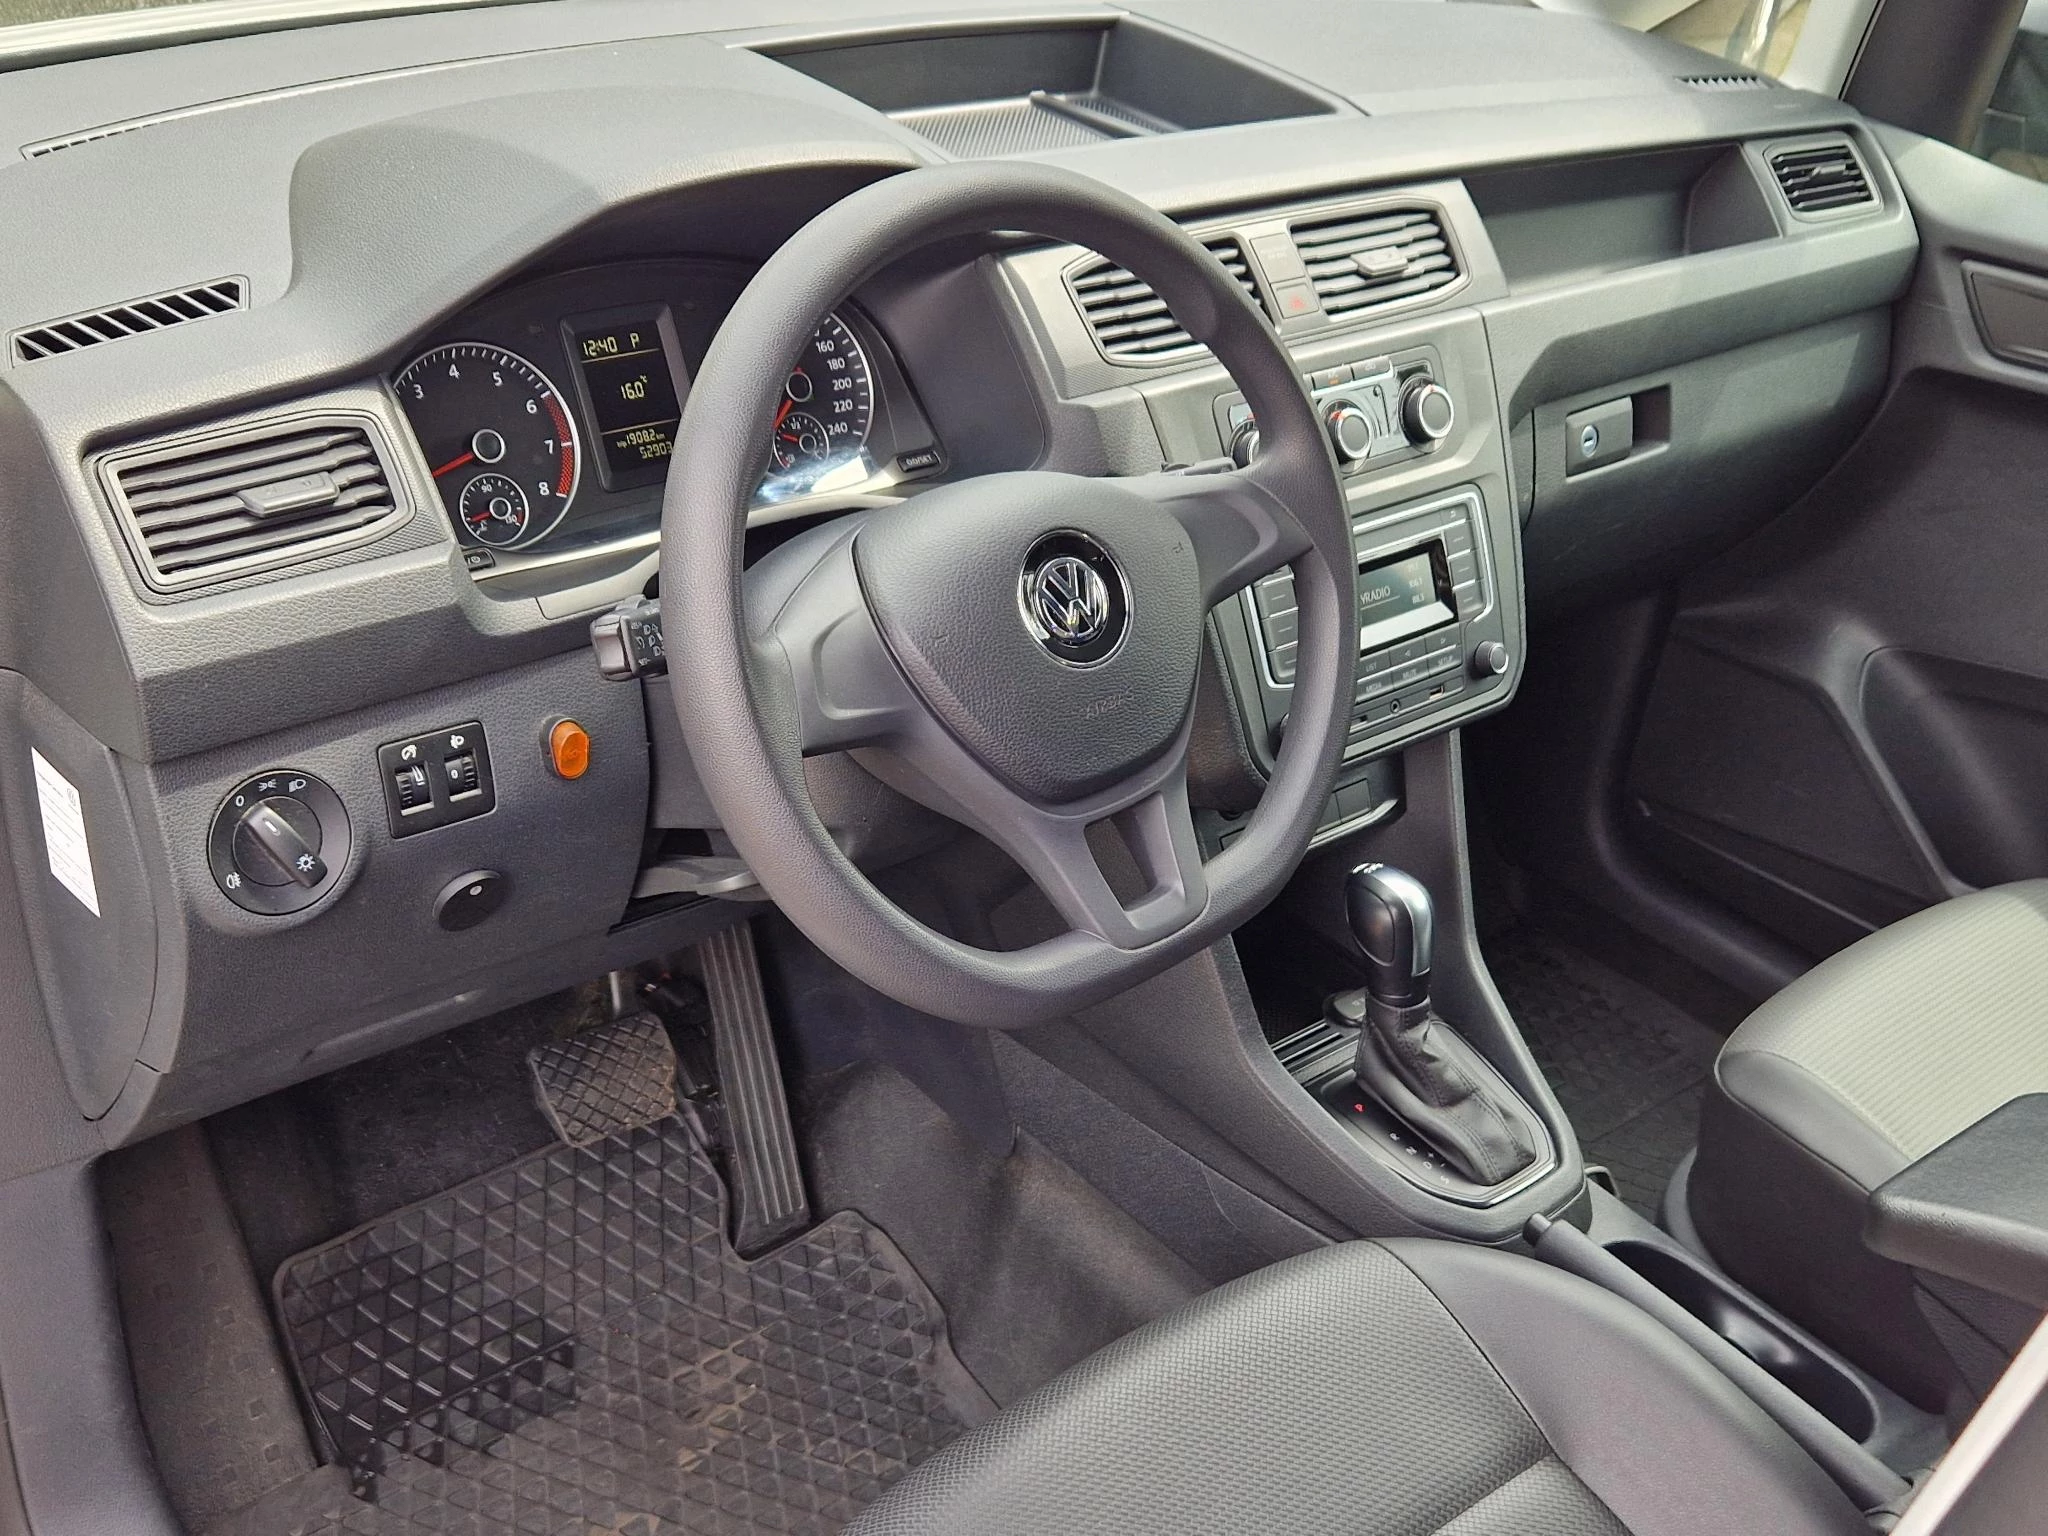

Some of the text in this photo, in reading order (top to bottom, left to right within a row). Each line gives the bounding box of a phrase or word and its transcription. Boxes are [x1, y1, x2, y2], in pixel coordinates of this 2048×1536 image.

[582, 332, 640, 357] 12:40 P
[815, 339, 835, 353] 160
[448, 363, 460, 380] 4
[827, 357, 845, 371] 180
[492, 371, 503, 387] 5
[832, 377, 852, 391] 200
[413, 383, 424, 399] 3
[525, 399, 537, 414] 6
[833, 398, 853, 413] 220
[827, 422, 848, 436] 240
[543, 439, 554, 455] 7
[481, 483, 493, 494] 90
[538, 481, 550, 496] 8
